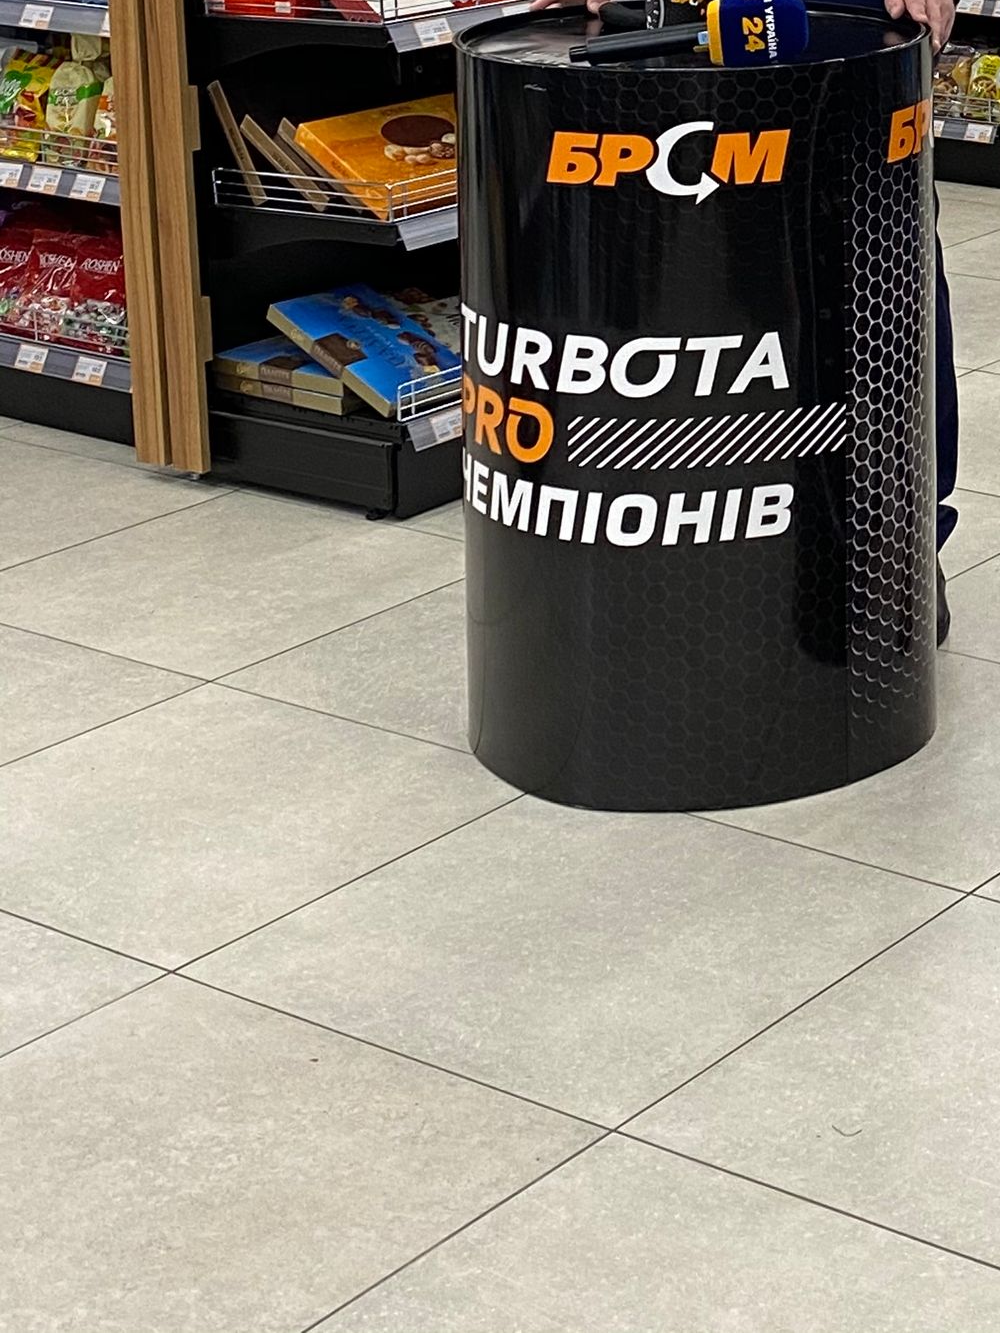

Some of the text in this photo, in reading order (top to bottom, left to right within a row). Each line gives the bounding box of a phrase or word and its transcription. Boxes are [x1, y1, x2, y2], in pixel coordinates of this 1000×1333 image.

[742, 16, 766, 53] 24
[546, 121, 791, 204] БРСМ
[0, 249, 29, 264] OSHEN
[81, 256, 121, 274] ROSHEN
[462, 371, 555, 464] PRO
